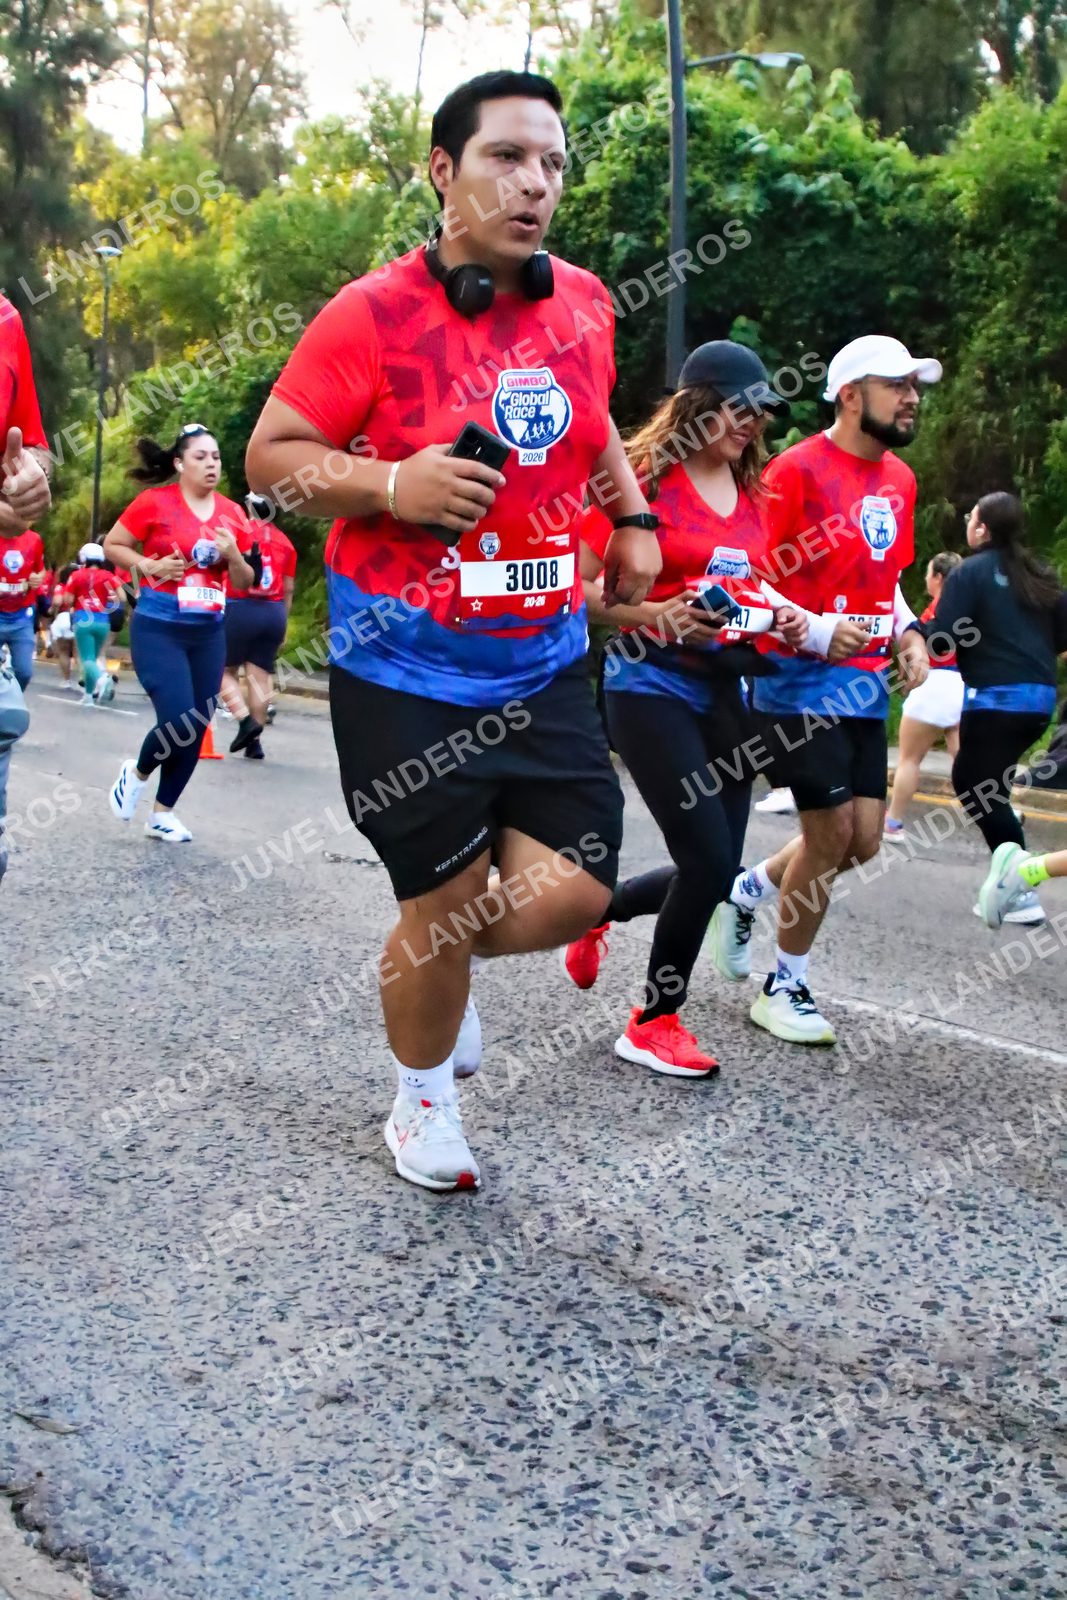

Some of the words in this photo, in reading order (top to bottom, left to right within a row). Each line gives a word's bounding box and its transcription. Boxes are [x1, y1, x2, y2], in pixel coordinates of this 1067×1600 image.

[506, 376, 547, 387] BIMBO
[510, 391, 550, 406] Global
[504, 406, 536, 419] Race
[522, 452, 544, 463] 2026
[506, 559, 558, 592] 3008
